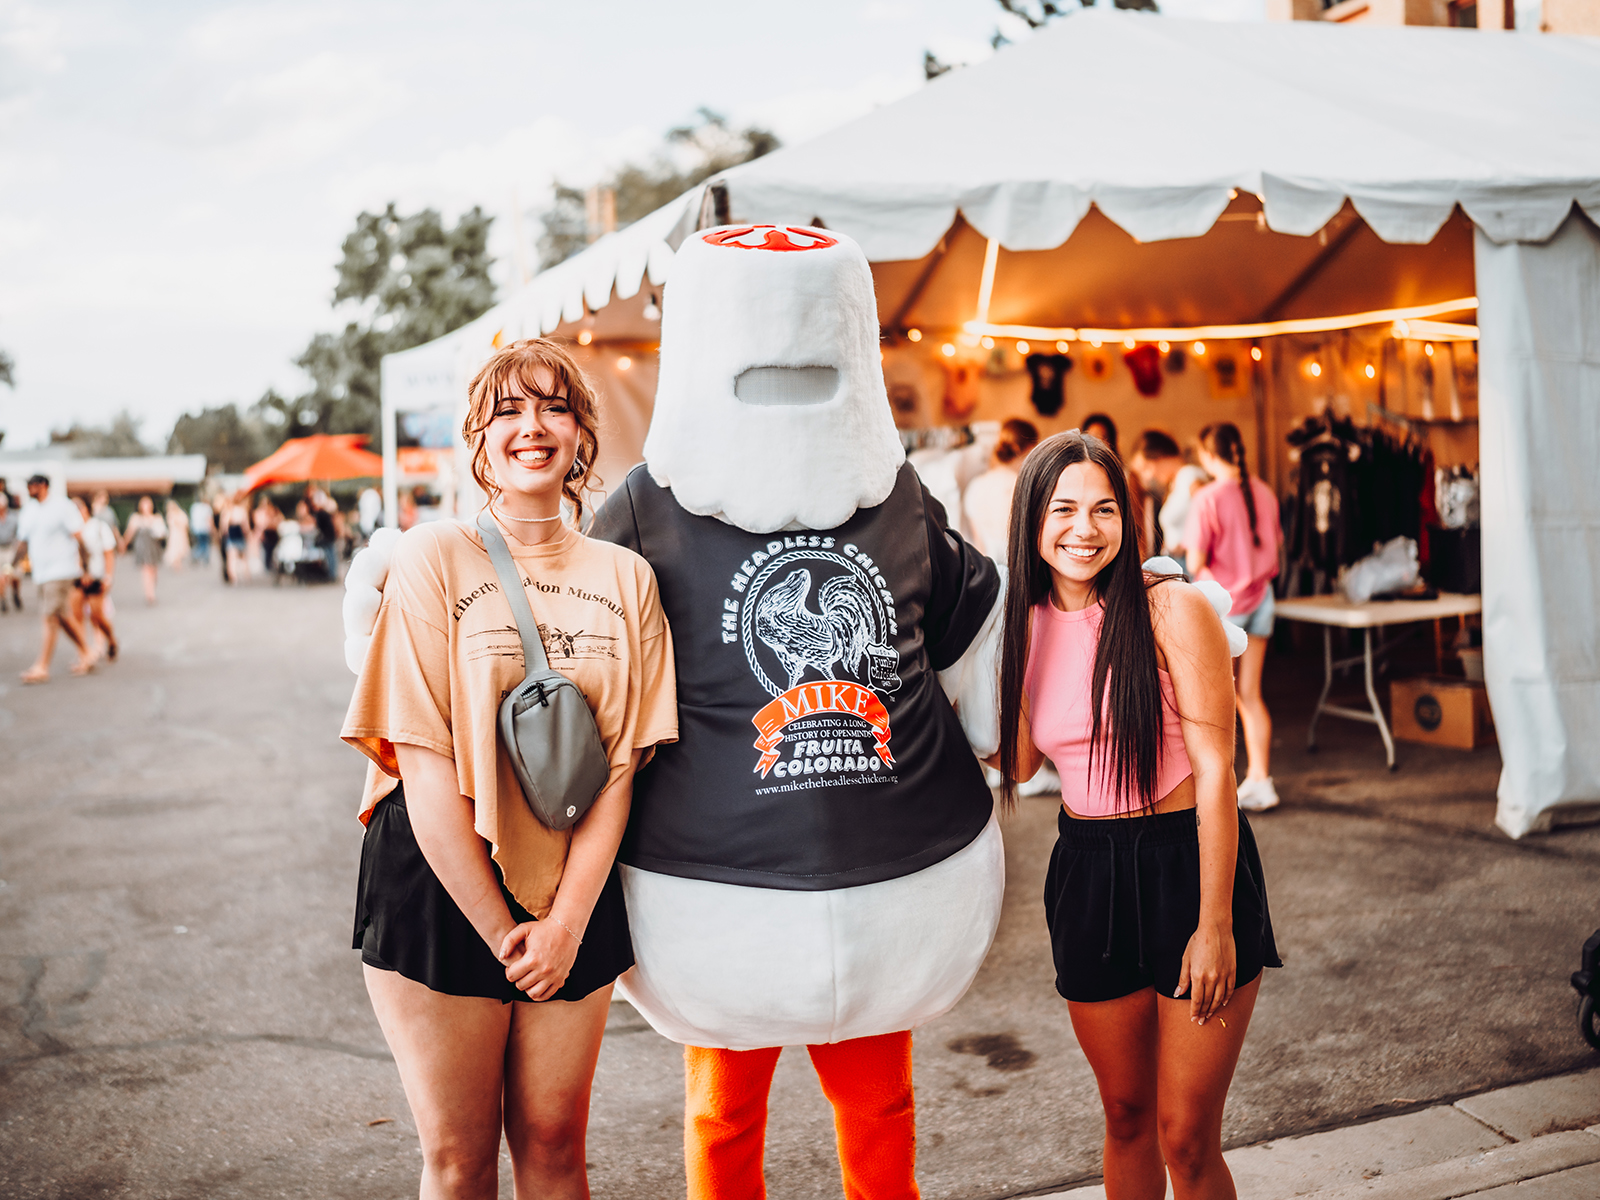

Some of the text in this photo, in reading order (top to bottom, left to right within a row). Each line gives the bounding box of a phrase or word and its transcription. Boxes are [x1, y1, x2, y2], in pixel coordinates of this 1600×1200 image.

[721, 536, 898, 644] THE HEADLESS CHICKEN
[452, 581, 499, 622] Liberty
[873, 657, 897, 671] Funky
[778, 684, 870, 722] MIKE
[788, 719, 867, 731] CELEBRATING A LONG
[784, 731, 819, 743] HISTORY
[820, 730, 831, 738] OF
[793, 738, 864, 758] FRUITA
[773, 756, 881, 778] COLORADO
[755, 773, 898, 796] www.miketheheadlesschicken.org
